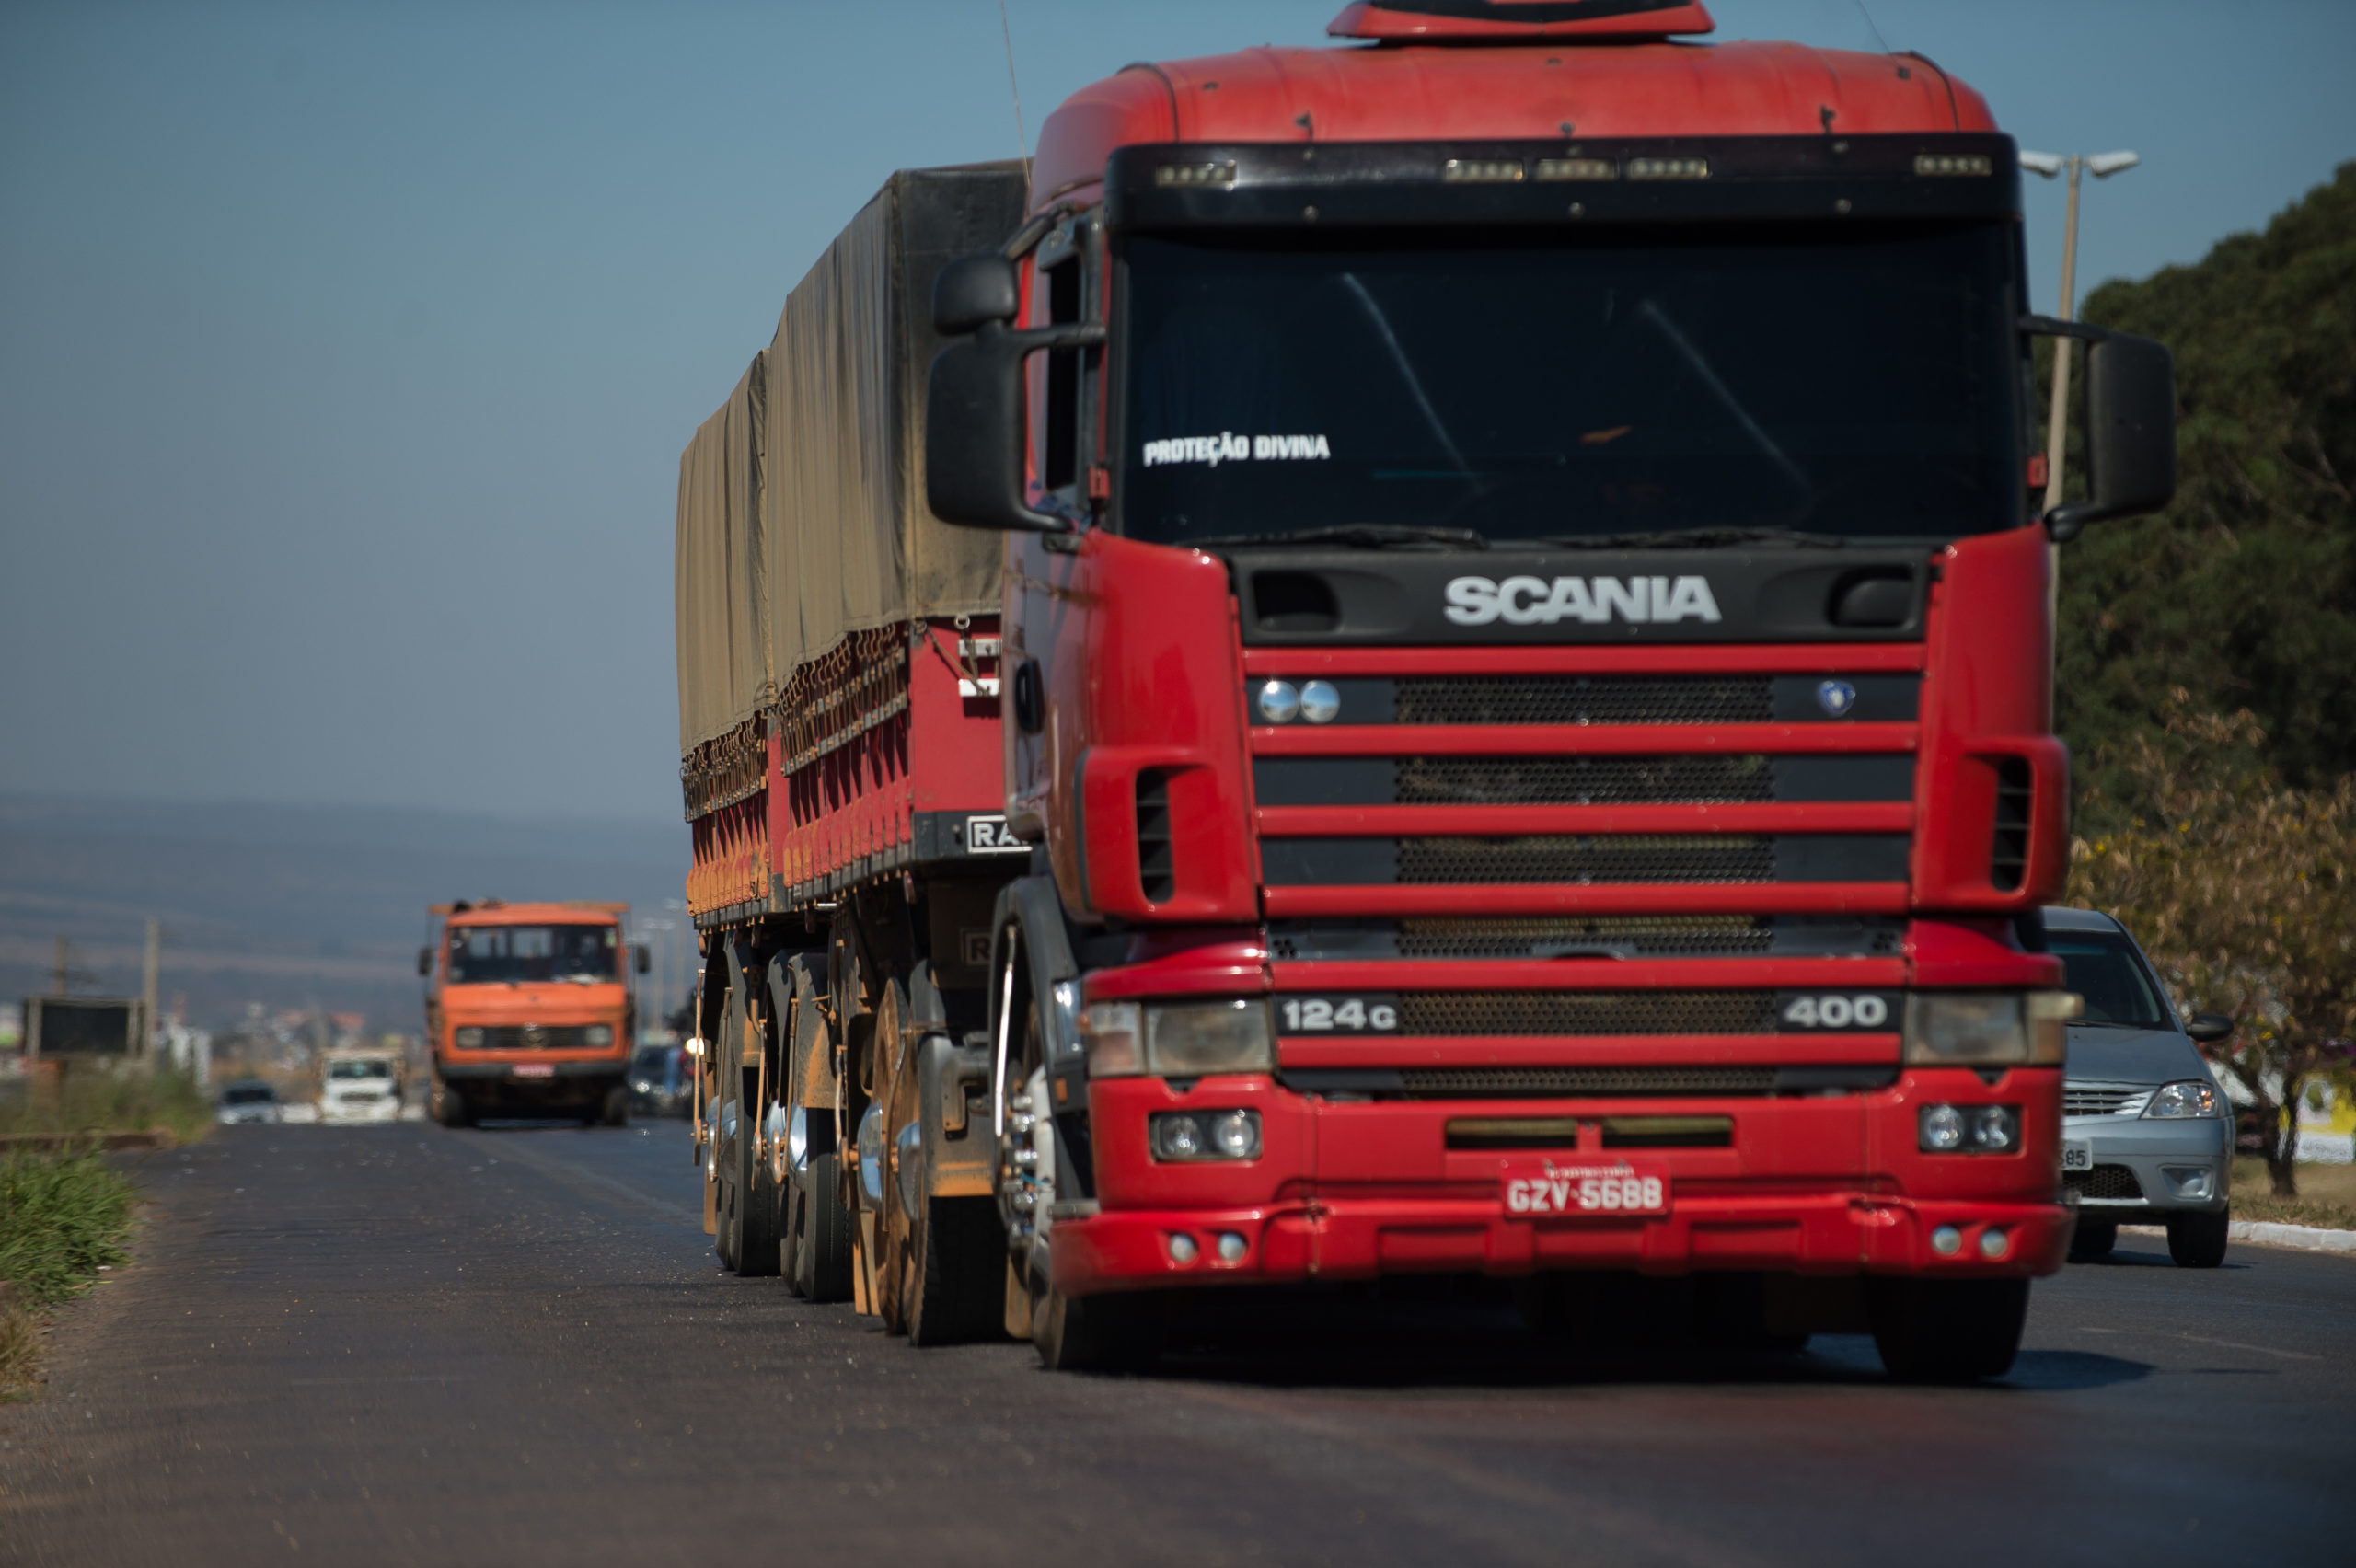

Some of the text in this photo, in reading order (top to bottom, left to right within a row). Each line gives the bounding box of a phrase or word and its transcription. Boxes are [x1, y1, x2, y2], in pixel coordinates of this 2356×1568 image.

[1143, 431, 1331, 467] PROTEÇÃO DIVINA
[1443, 575, 1723, 626] SCANIA
[973, 823, 1029, 847] RA
[1784, 994, 1888, 1028] 400
